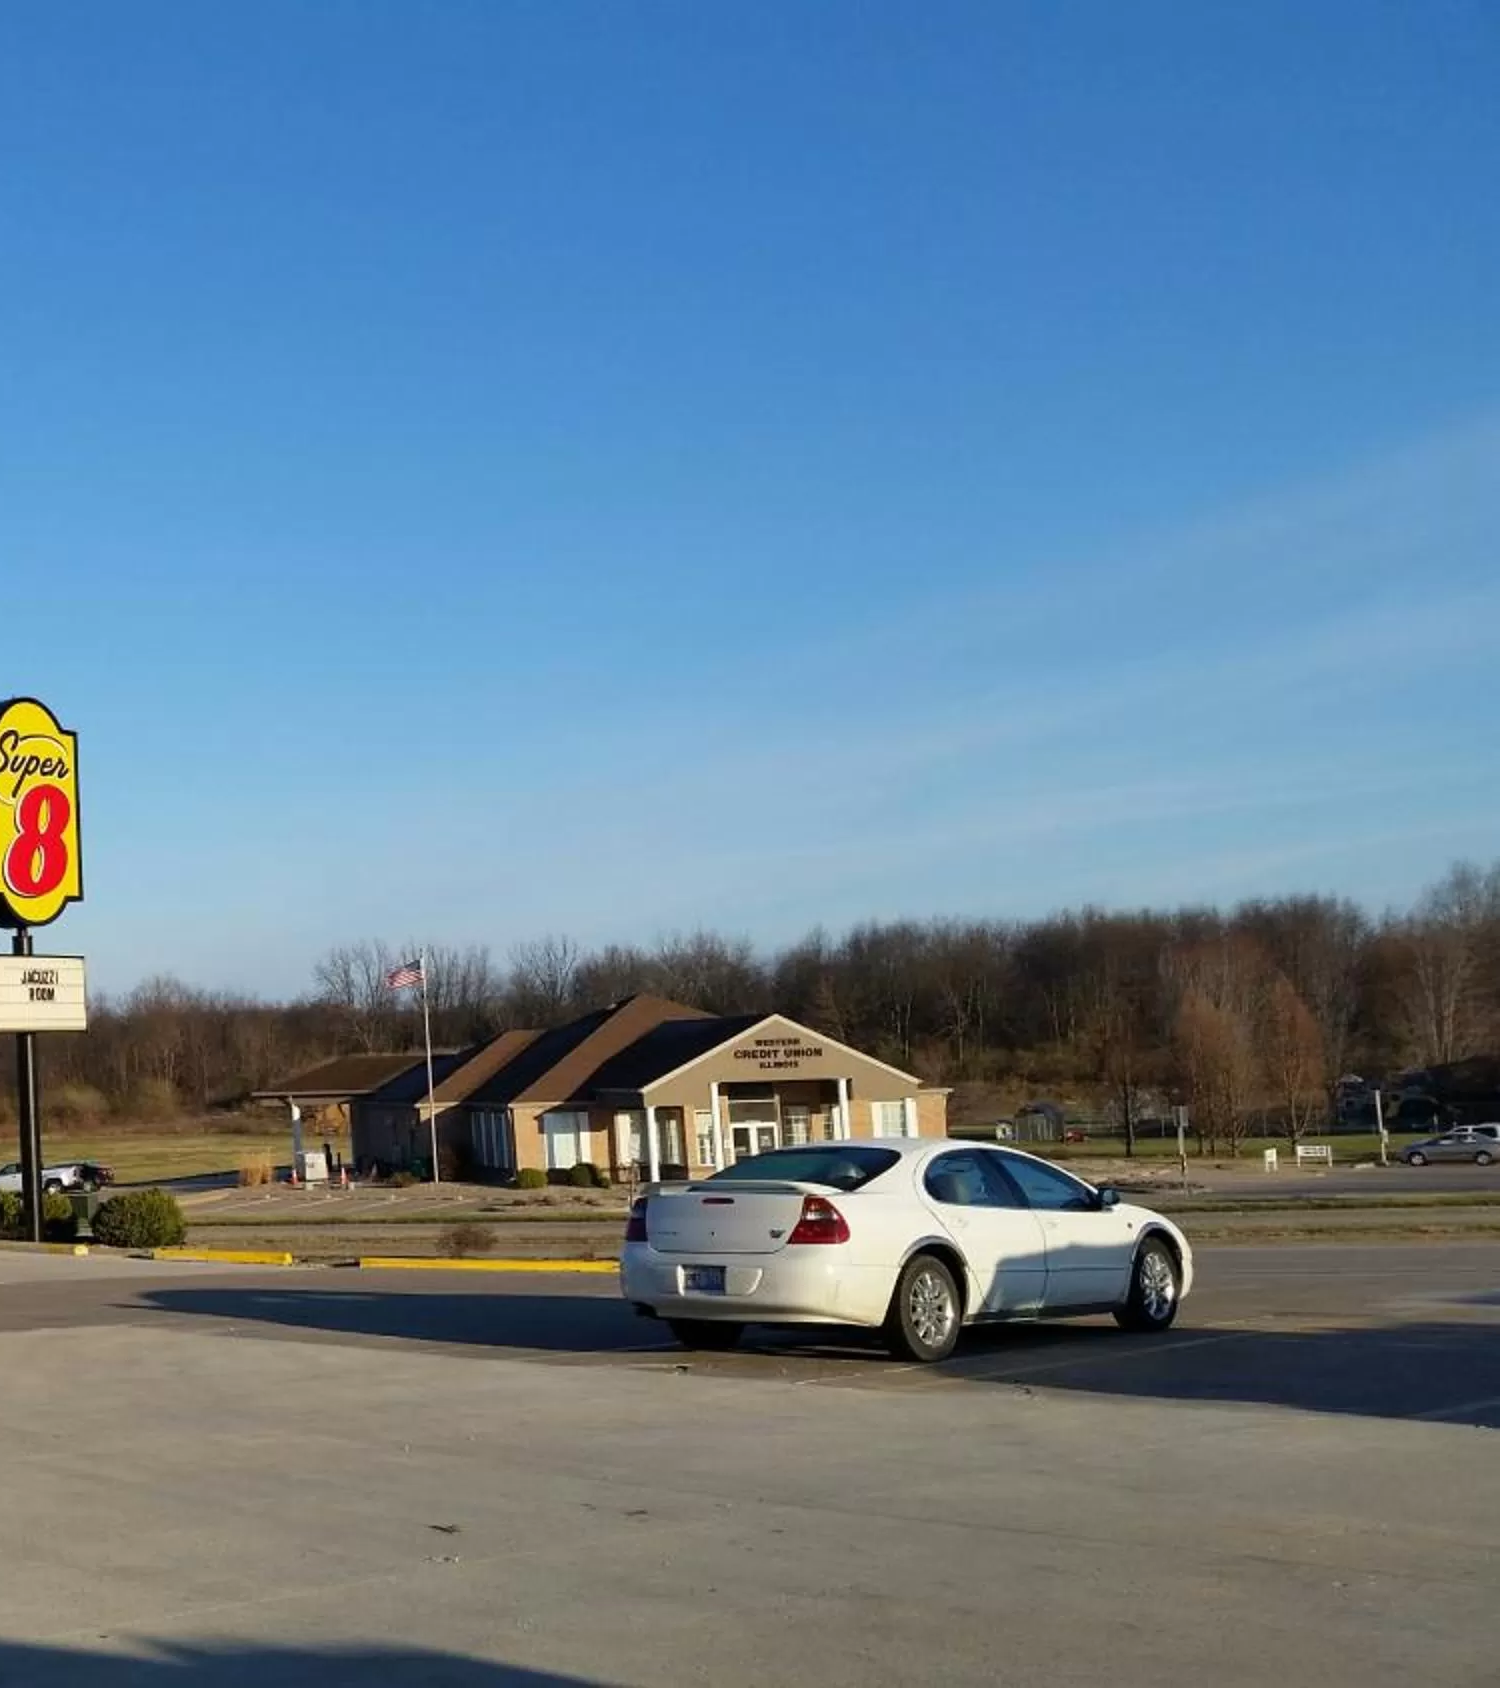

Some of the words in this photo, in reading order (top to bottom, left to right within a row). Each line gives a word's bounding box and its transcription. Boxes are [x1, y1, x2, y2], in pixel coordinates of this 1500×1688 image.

[4, 783, 71, 896] 8
[21, 969, 59, 985] JACUZZI
[29, 987, 55, 1001] ROOM
[733, 1049, 779, 1060] CREDIT
[783, 1047, 823, 1059] UNION
